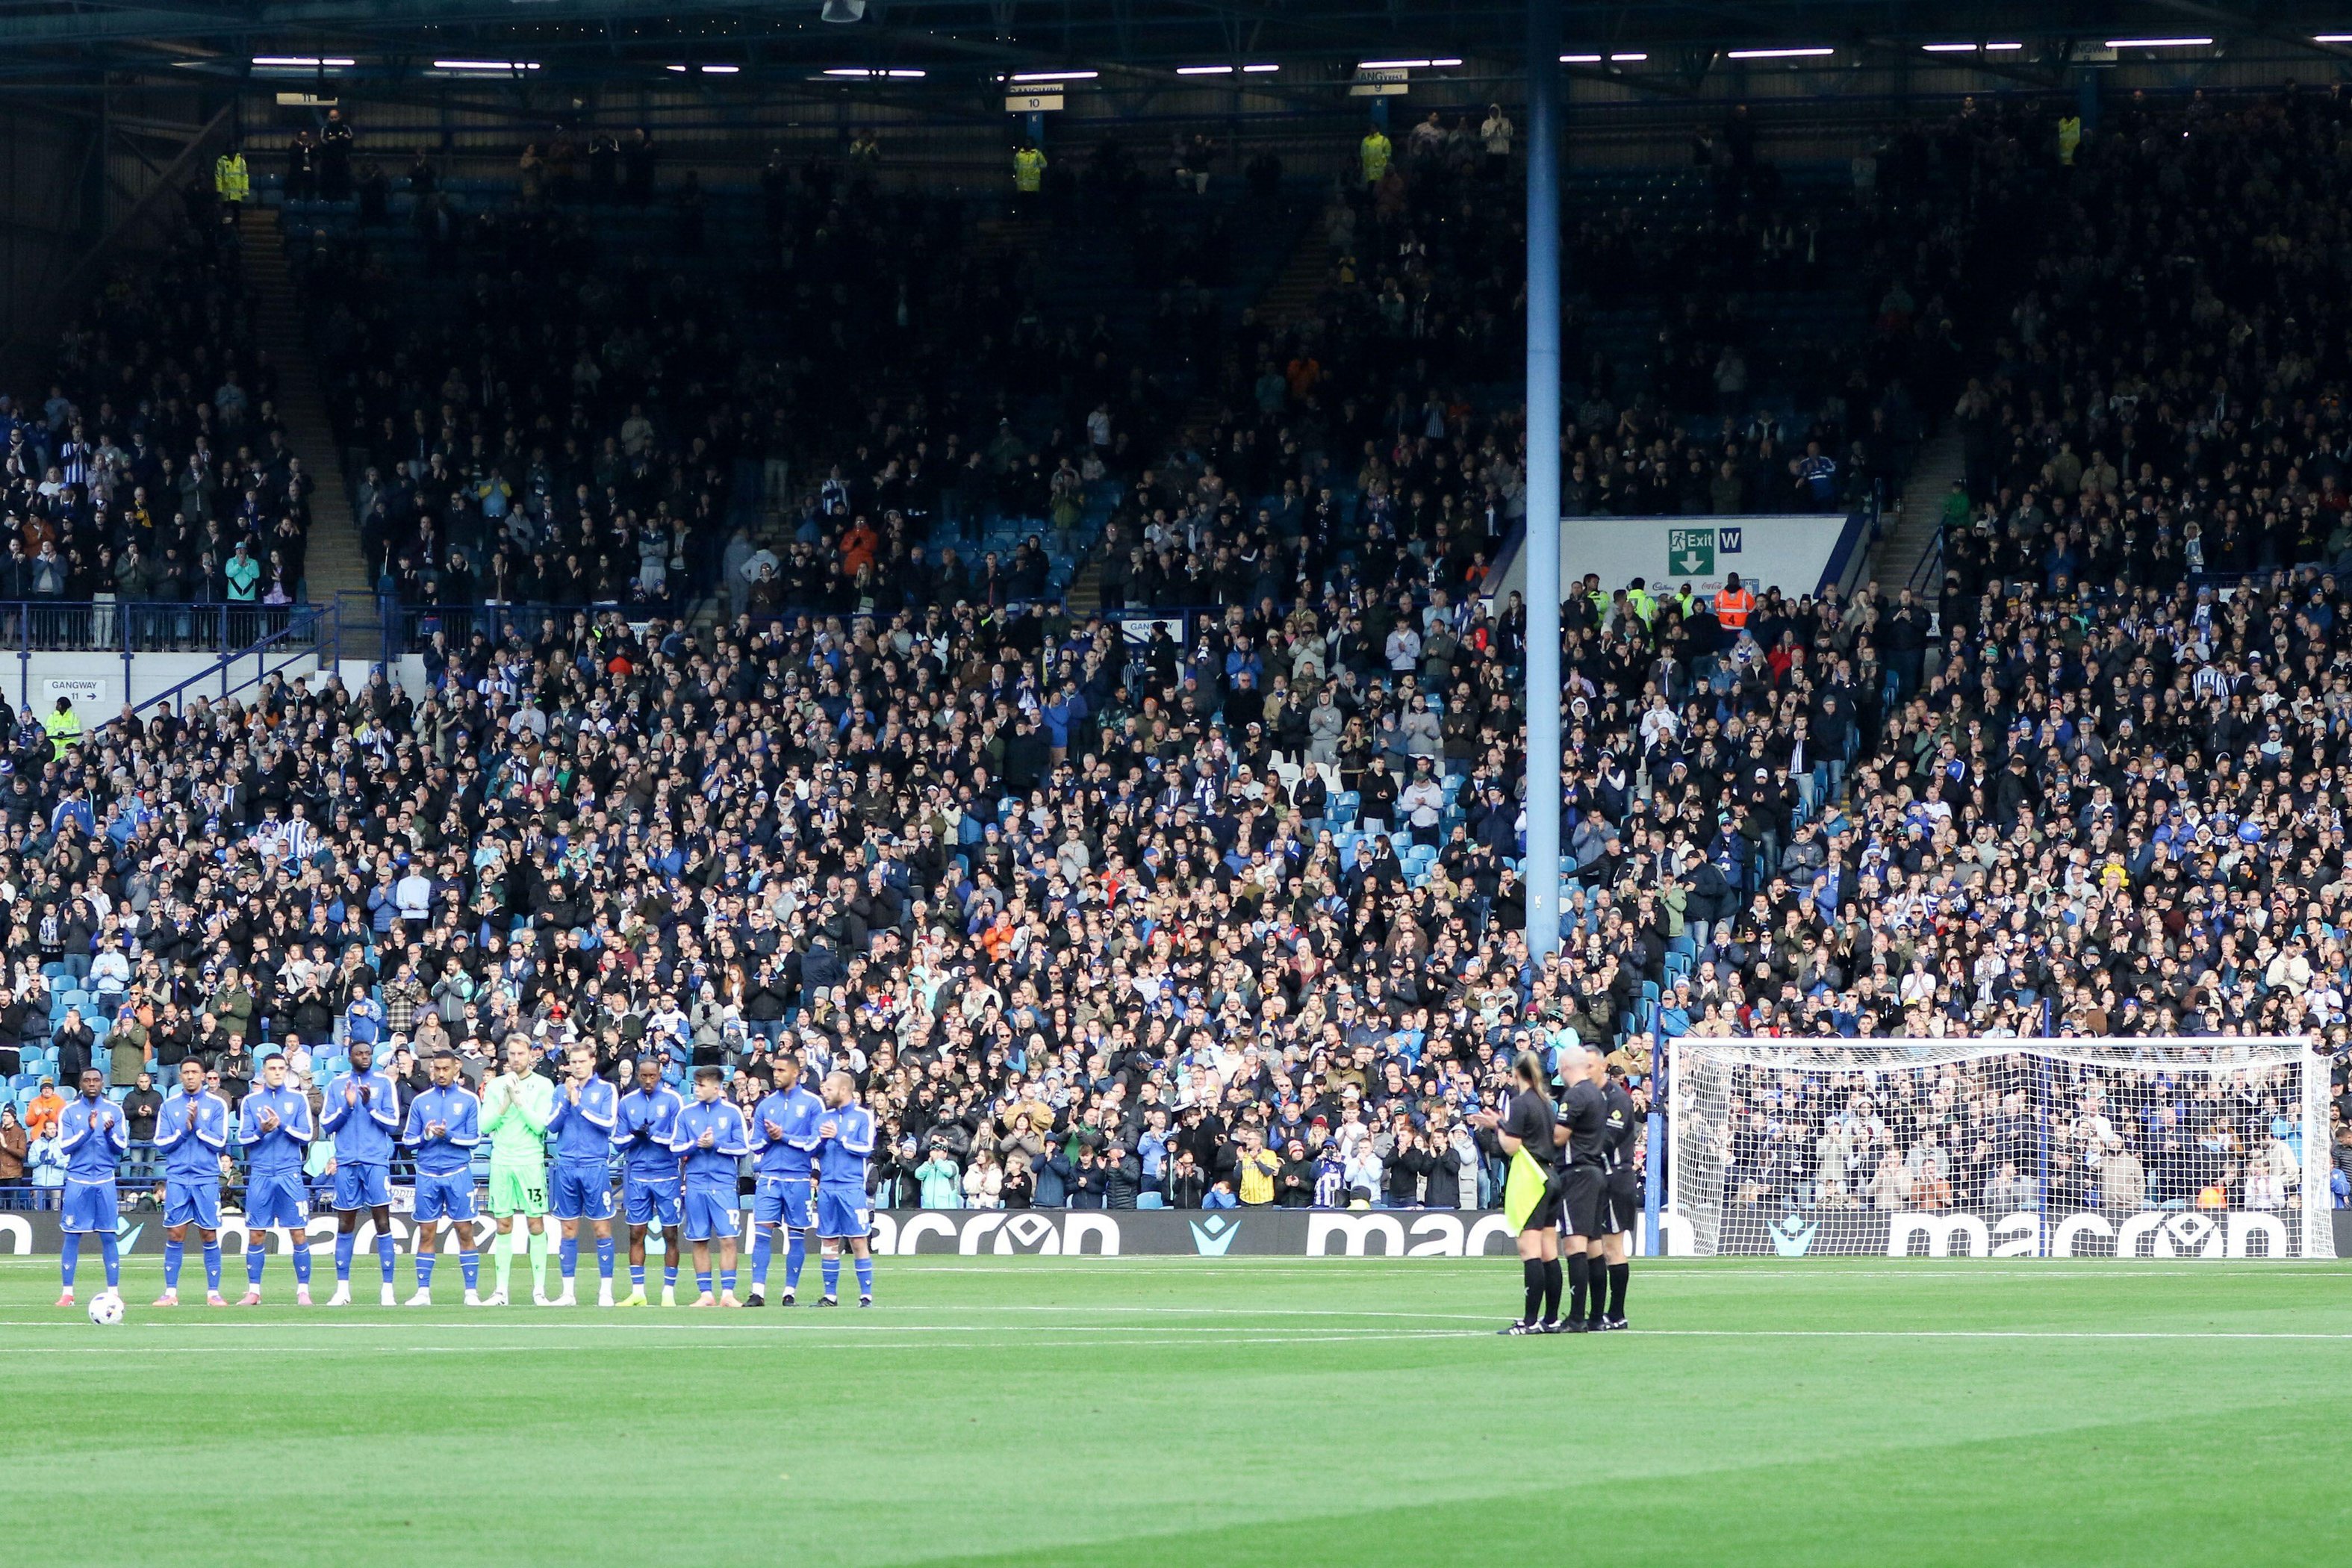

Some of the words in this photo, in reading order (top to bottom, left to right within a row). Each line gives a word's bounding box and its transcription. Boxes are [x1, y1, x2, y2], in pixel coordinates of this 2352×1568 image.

[1029, 99, 1040, 108] 10
[1687, 535, 1713, 547] Exit
[1721, 532, 1739, 549] W
[1728, 615, 1736, 625] 4
[52, 681, 97, 689] GANGWAY
[71, 692, 79, 700] 11
[1534, 895, 1542, 904] K
[527, 1188, 542, 1203] 13
[602, 1191, 612, 1207] 8
[726, 1209, 740, 1225] 12
[854, 1208, 869, 1225] 10
[1888, 1212, 2288, 1257] macron
